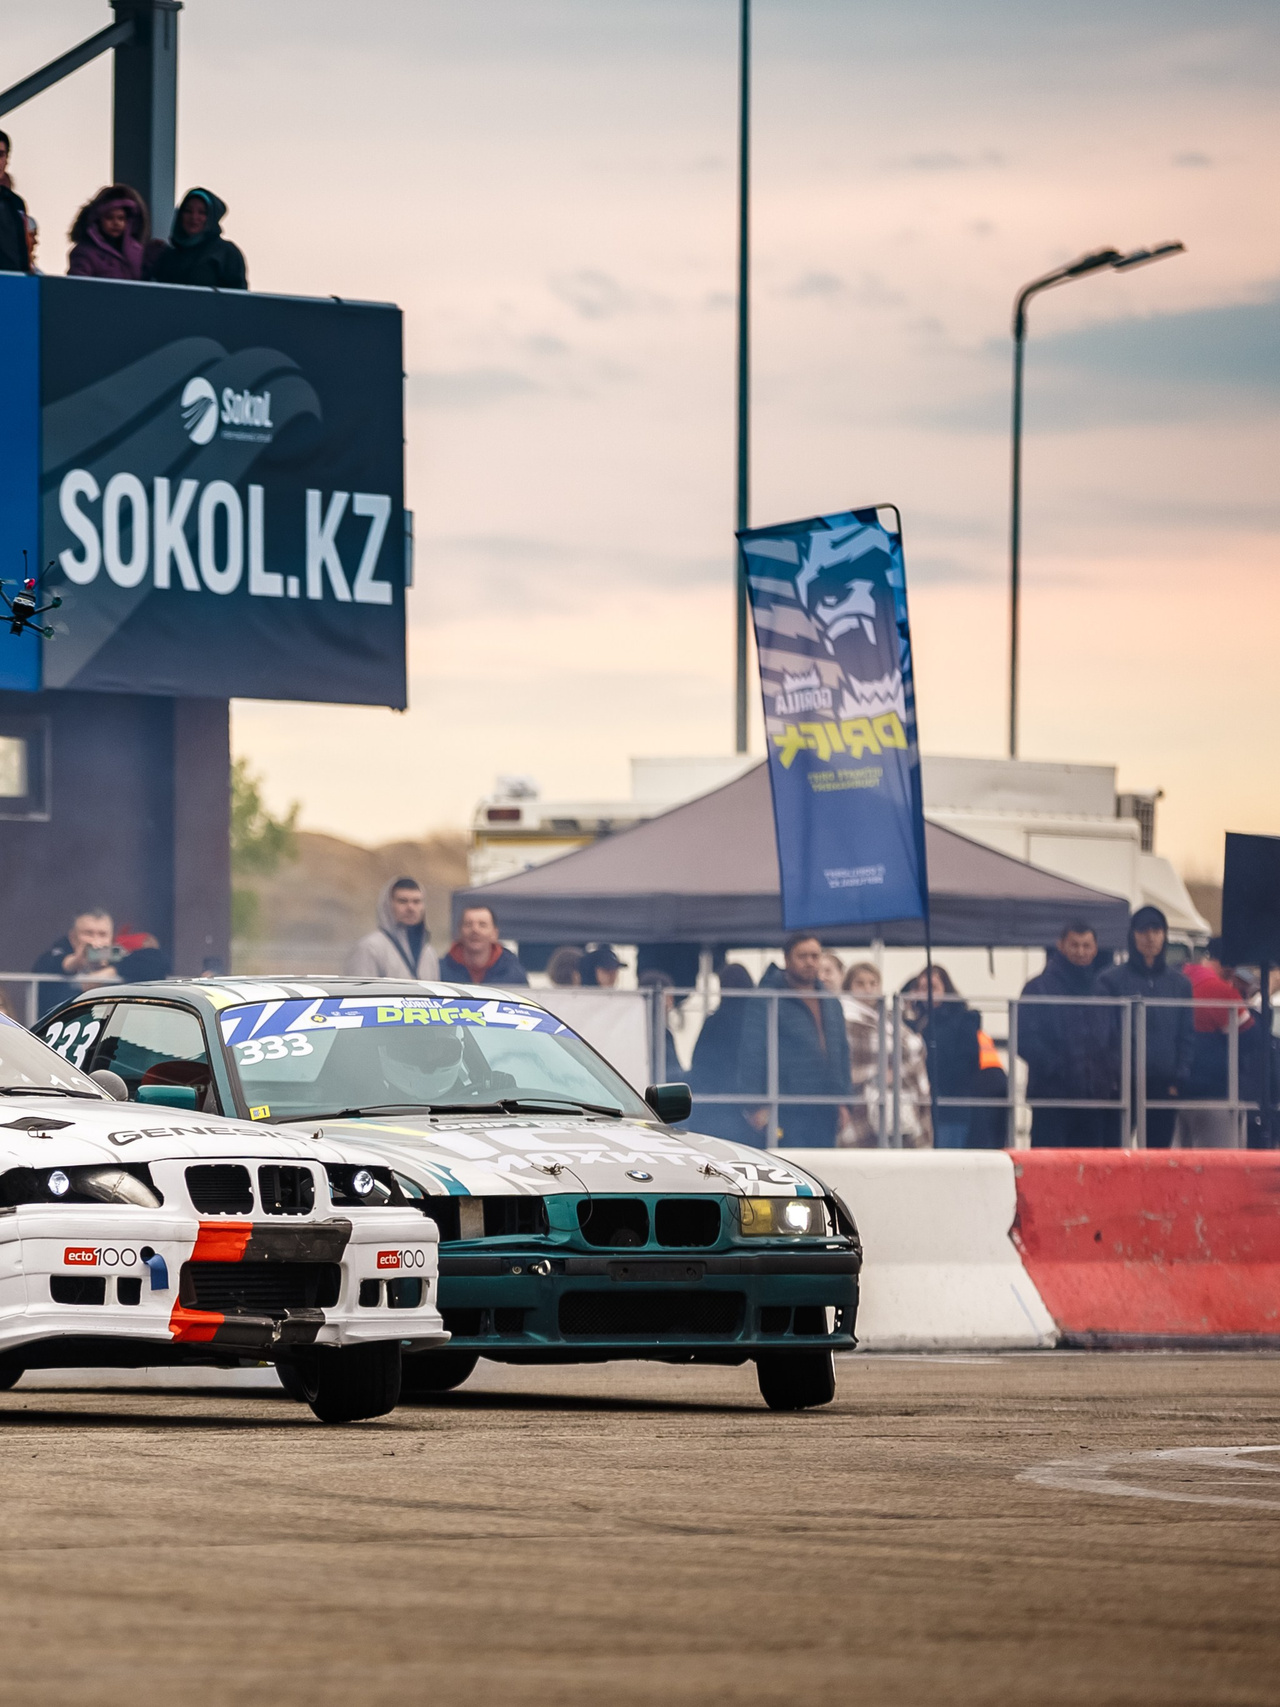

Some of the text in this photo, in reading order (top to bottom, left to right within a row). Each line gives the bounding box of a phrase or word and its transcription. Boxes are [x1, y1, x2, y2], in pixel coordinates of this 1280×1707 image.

[59, 468, 393, 606] SOKOL.KZ
[401, 999, 442, 1009] GORILLA
[377, 1006, 487, 1027] DRIFT
[235, 1033, 314, 1066] 333
[68, 1247, 138, 1267] ecto100
[380, 1249, 426, 1268] ecto100
